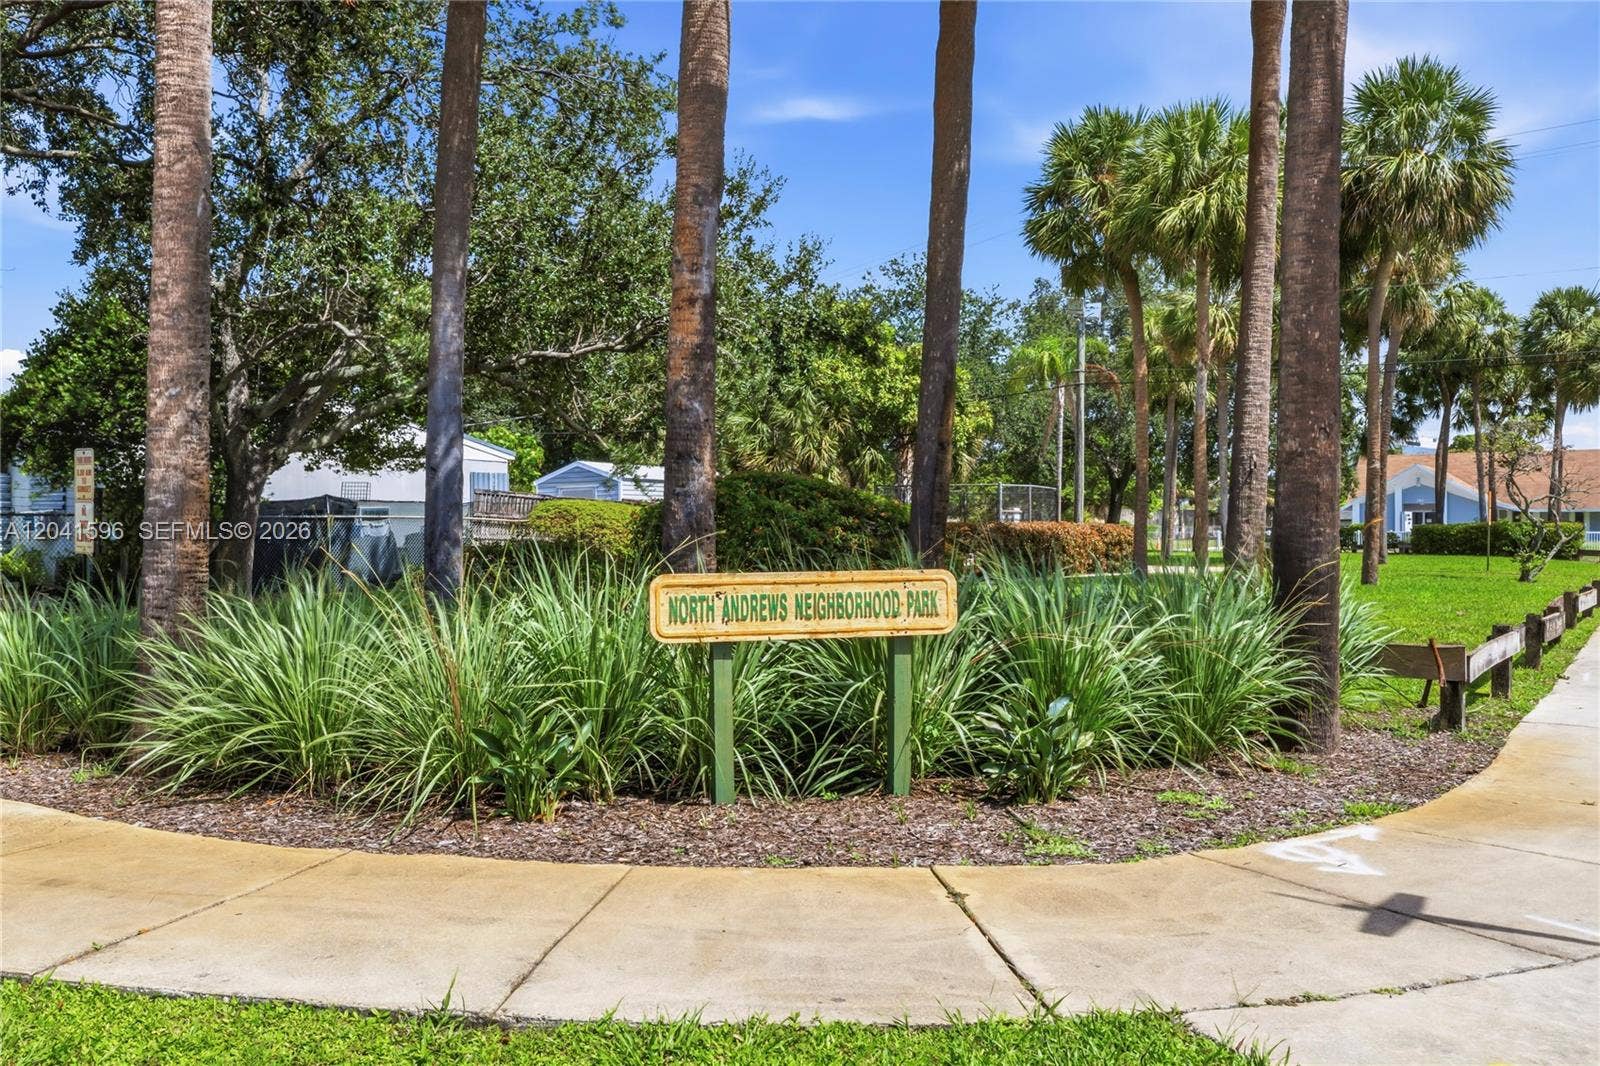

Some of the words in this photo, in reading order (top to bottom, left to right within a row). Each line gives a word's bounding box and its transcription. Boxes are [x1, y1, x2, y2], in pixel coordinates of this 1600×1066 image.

[668, 594, 715, 625] NORTH
[721, 592, 788, 624] ANDREWS
[794, 589, 900, 621] NEIGHBORHOOD
[906, 589, 940, 618] PARK
